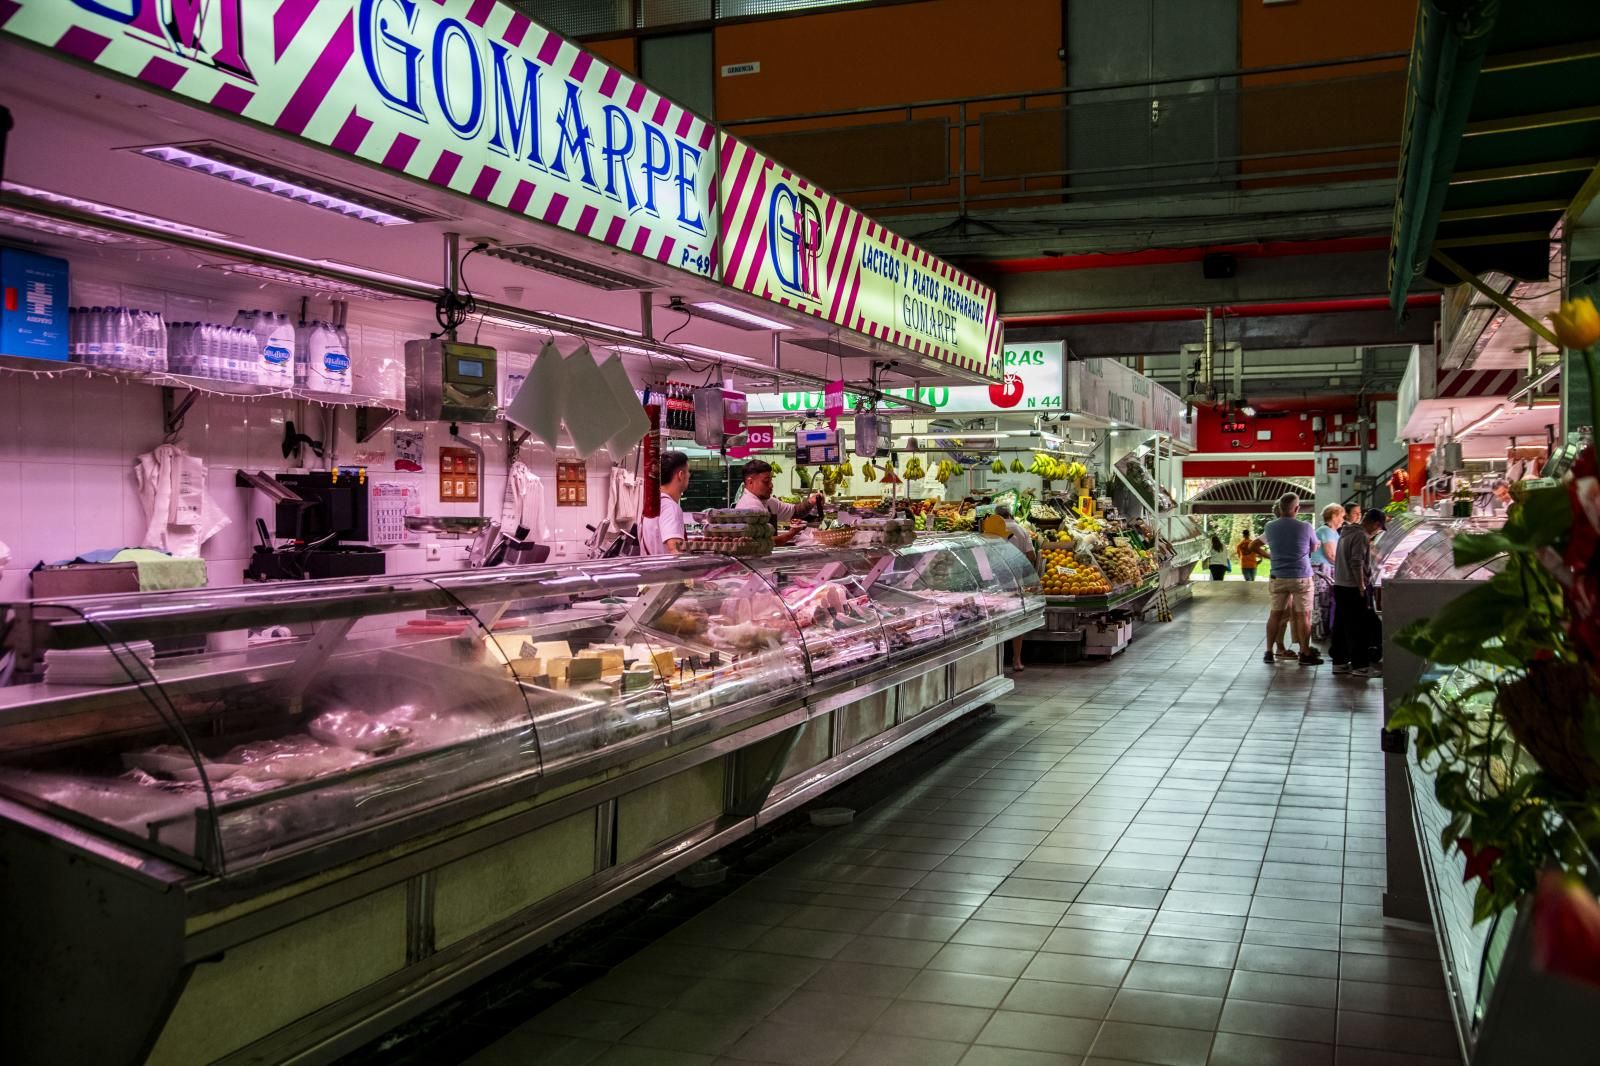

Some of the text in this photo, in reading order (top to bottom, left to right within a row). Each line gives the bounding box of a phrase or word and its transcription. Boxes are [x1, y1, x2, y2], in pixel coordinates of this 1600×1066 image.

[358, 0, 707, 237] GOMARPE
[861, 241, 985, 324] LACTEOS Y PLATOS PREPARADOS
[902, 294, 958, 346] GOMARPE
[1027, 395, 1061, 408] N 44
